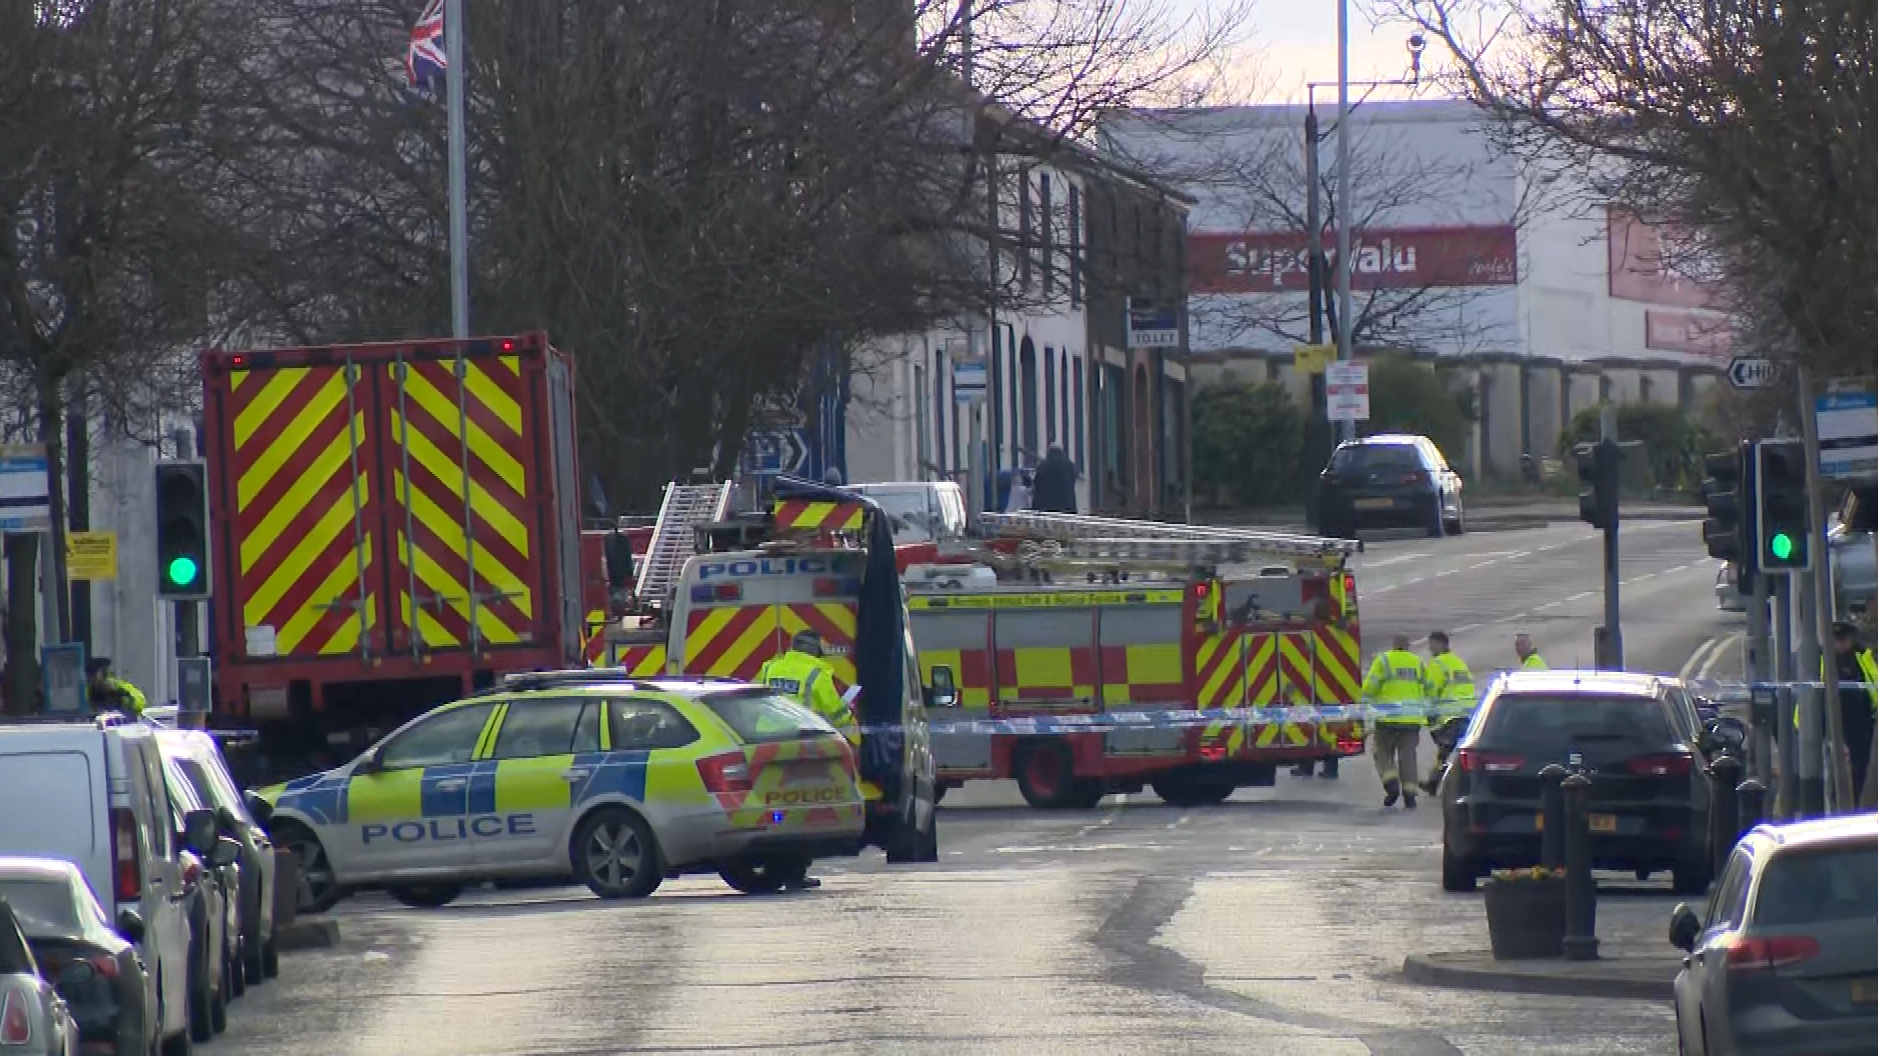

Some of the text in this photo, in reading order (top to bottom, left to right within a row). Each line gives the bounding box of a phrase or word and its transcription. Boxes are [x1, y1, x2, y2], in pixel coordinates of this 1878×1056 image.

[699, 558, 853, 580] POLIC
[765, 787, 844, 805] POLICE
[361, 813, 537, 845] POLICE
